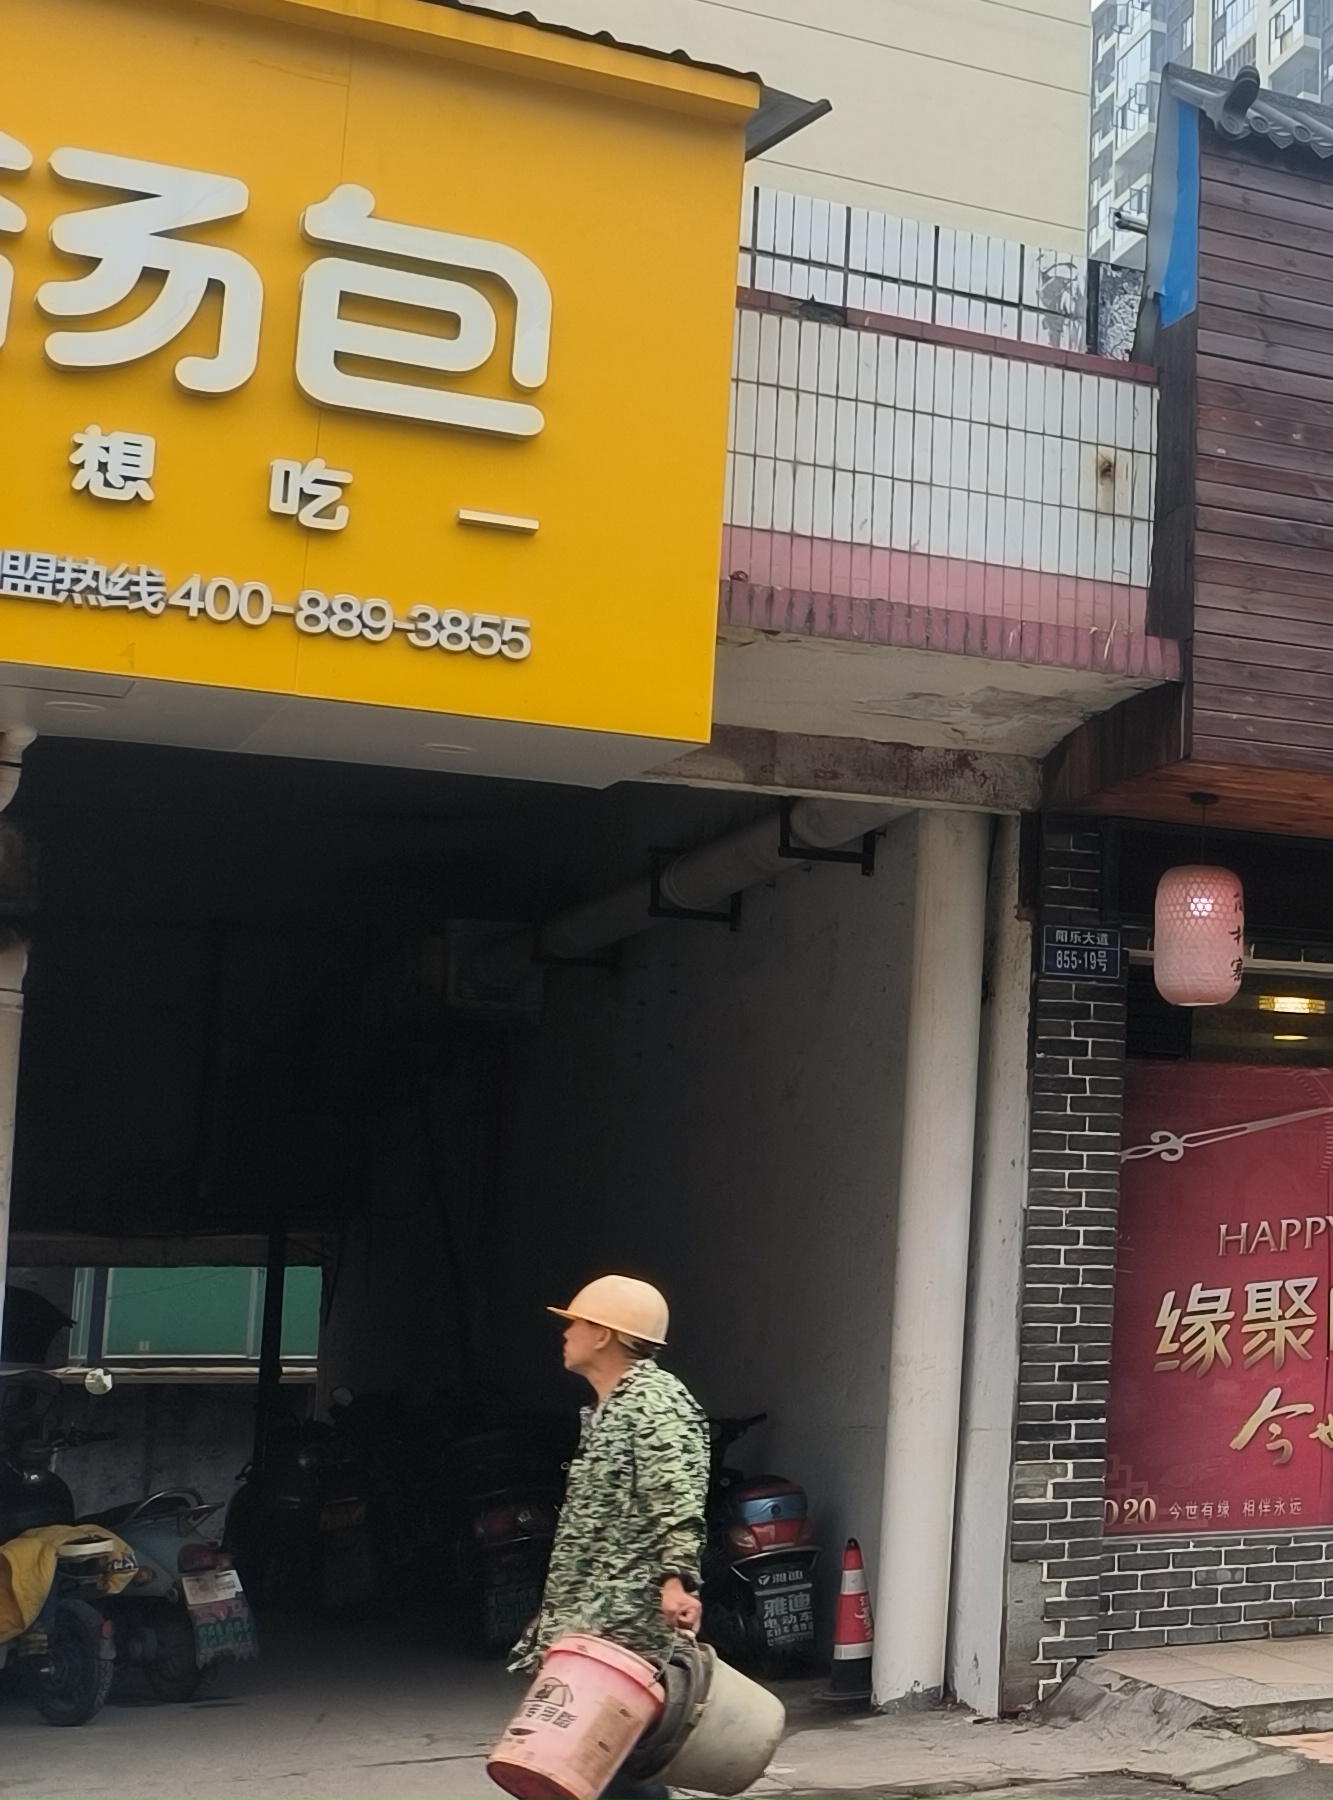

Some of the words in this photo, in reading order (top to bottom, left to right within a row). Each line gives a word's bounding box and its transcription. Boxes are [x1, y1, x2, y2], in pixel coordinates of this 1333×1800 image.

[1055, 929, 1109, 946] 阳乐大道
[1168, 1501, 1231, 1522] 今世有缘
[1242, 1497, 1302, 1517] 相伴永远
